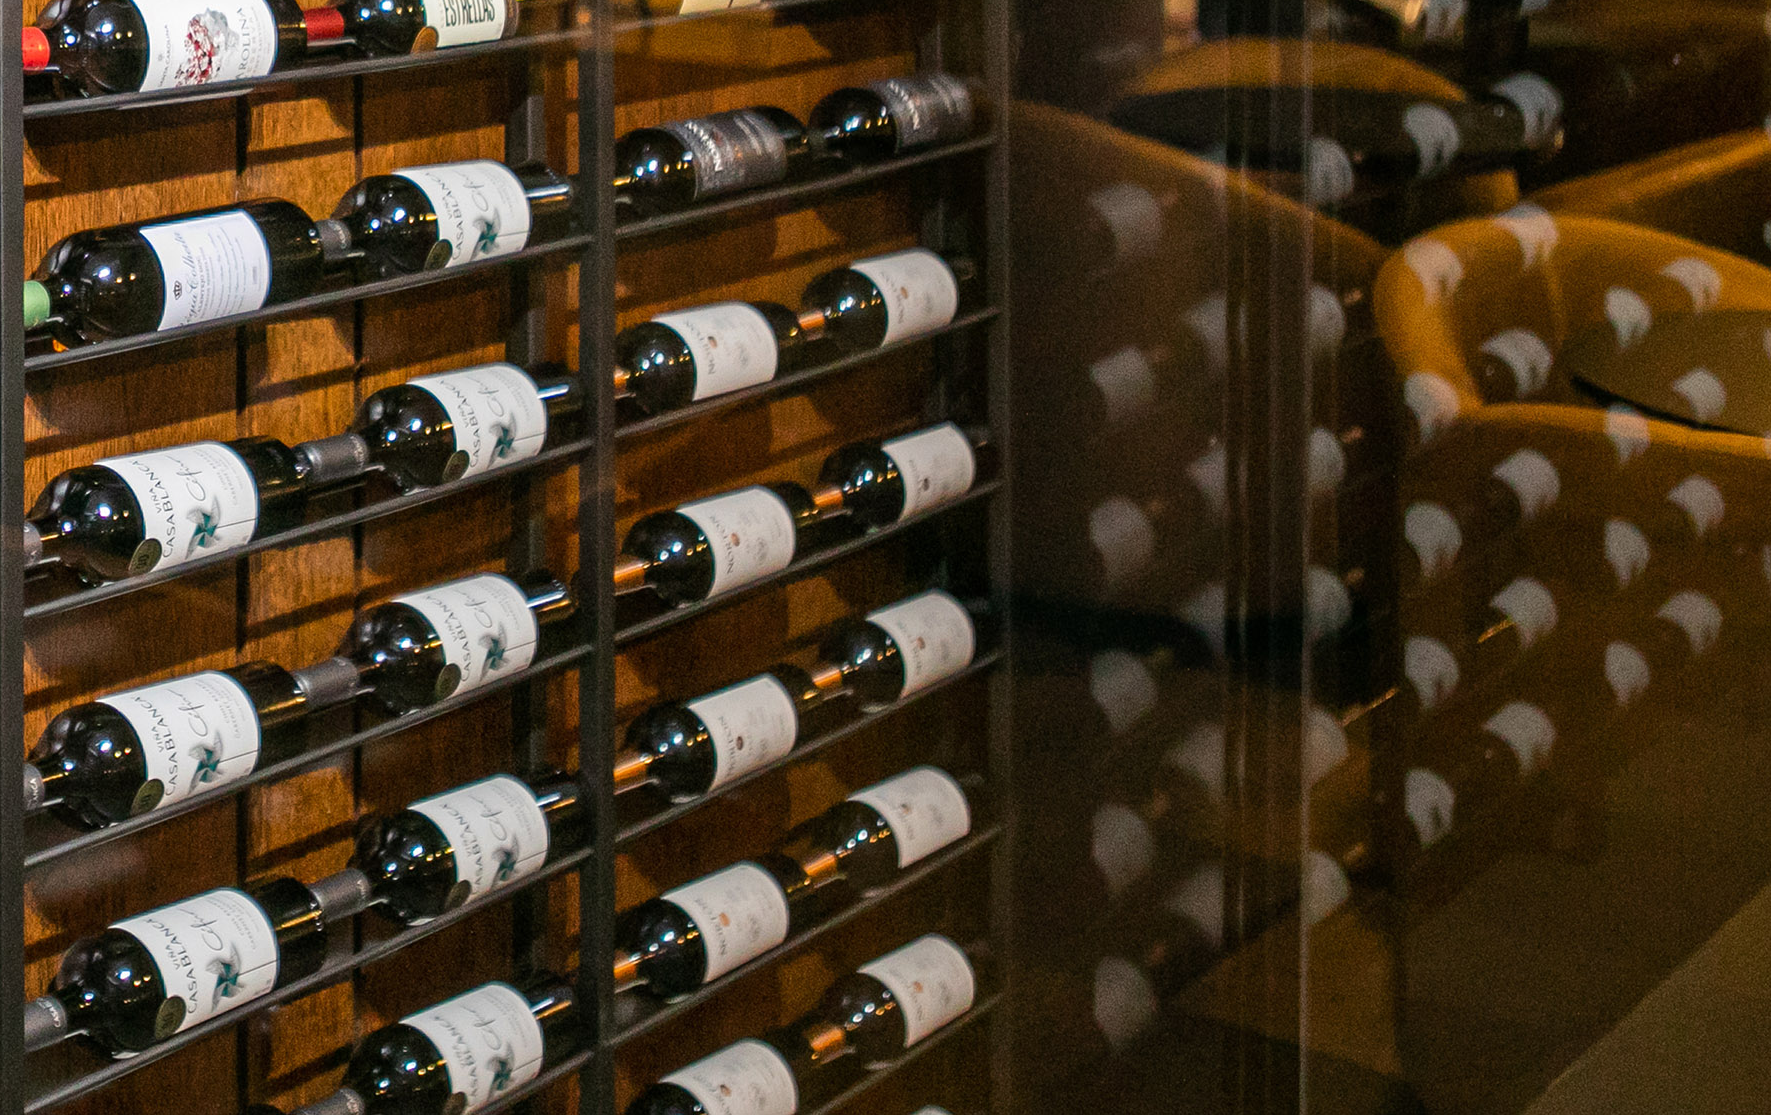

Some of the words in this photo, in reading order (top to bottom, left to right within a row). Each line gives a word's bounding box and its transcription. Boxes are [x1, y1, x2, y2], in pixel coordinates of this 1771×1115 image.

[235, 6, 252, 80] AROLINA
[424, 172, 465, 261] CASABLANCA
[439, 380, 481, 468] CASABLANCA
[131, 460, 176, 558] CASABLANCA
[425, 594, 471, 682] CASABLANCA
[133, 695, 179, 796] CASABLANCA
[144, 917, 198, 1014] CASABLANCA
